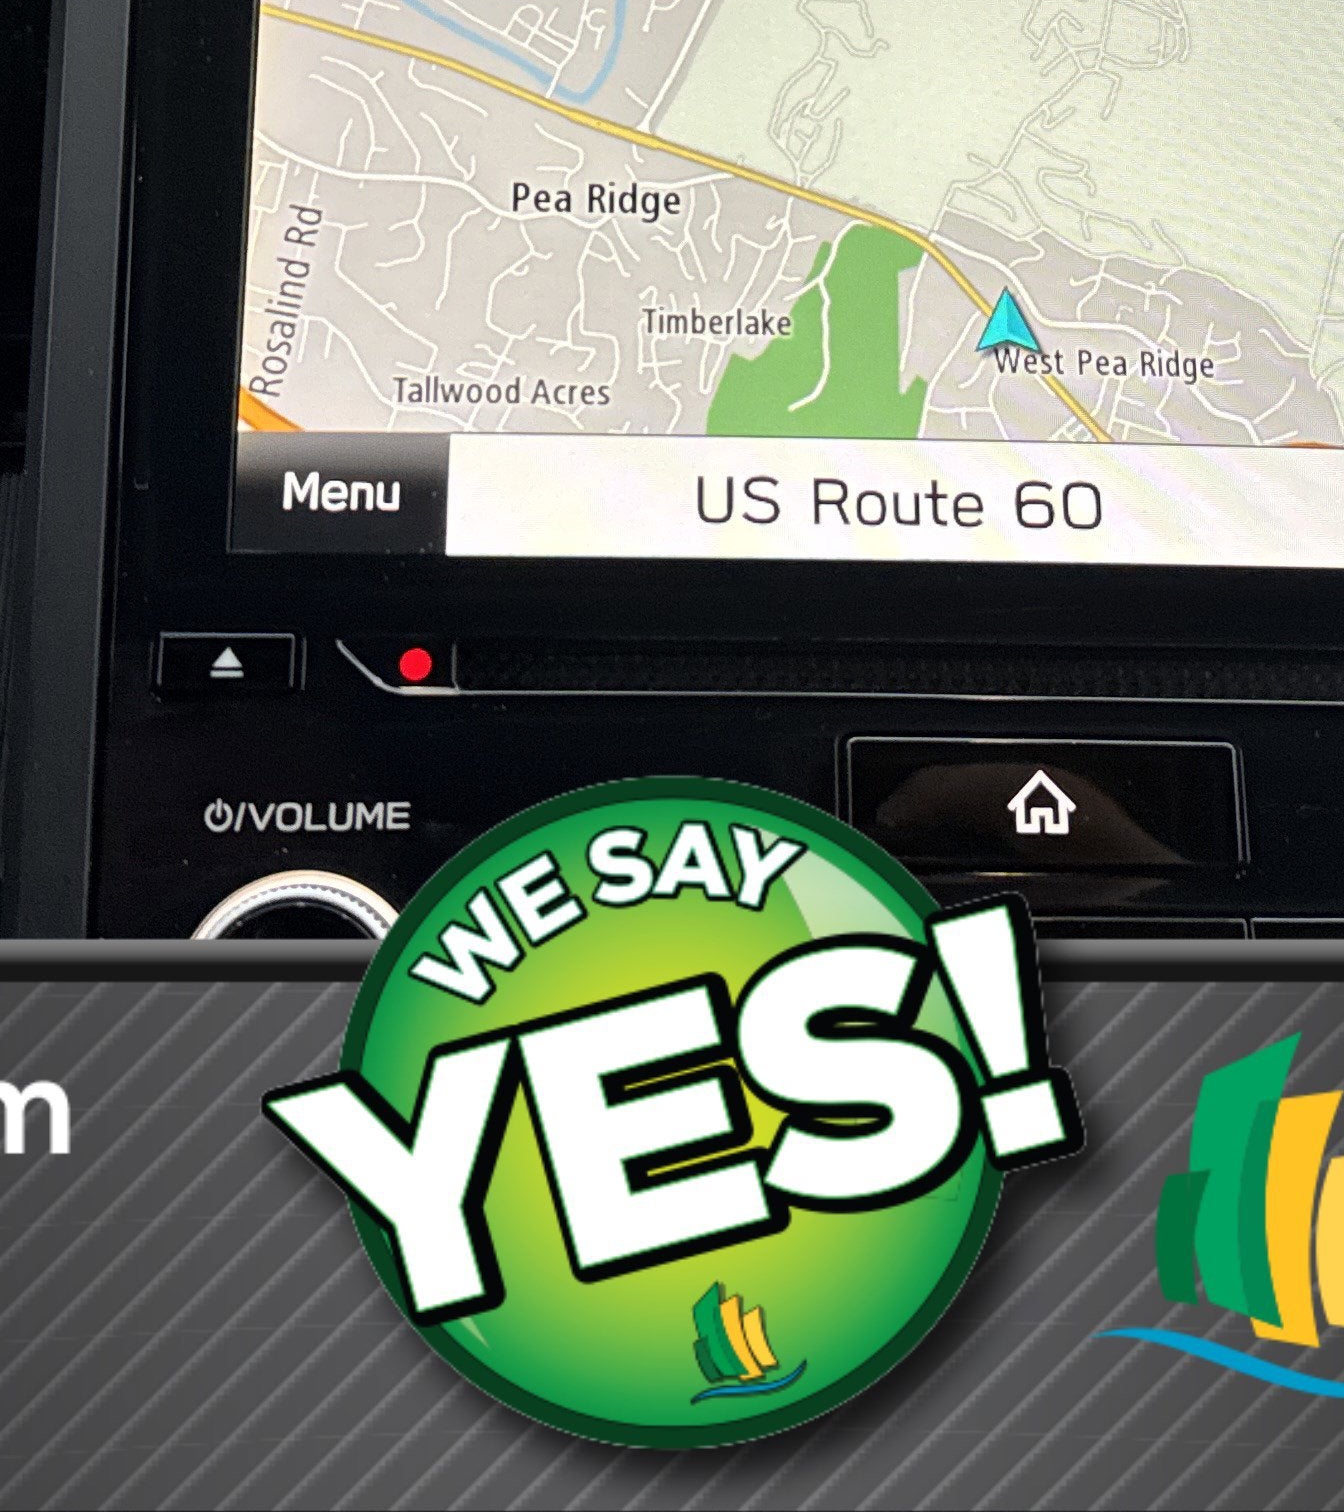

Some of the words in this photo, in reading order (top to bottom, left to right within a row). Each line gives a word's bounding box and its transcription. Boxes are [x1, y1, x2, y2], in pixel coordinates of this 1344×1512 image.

[513, 183, 572, 213] Pea
[588, 182, 681, 223] Ridge
[249, 256, 311, 397] Rosalind
[283, 204, 324, 248] Rd
[644, 308, 792, 336] Timberlake
[994, 346, 1064, 376] West
[1078, 349, 1127, 376] Pea
[1140, 349, 1214, 385] Ridge
[395, 376, 521, 404] Tallwood
[531, 379, 610, 406] Acres
[282, 470, 401, 512] Menu
[697, 475, 781, 525] US
[813, 478, 984, 528] Route
[1014, 480, 1103, 530] 60
